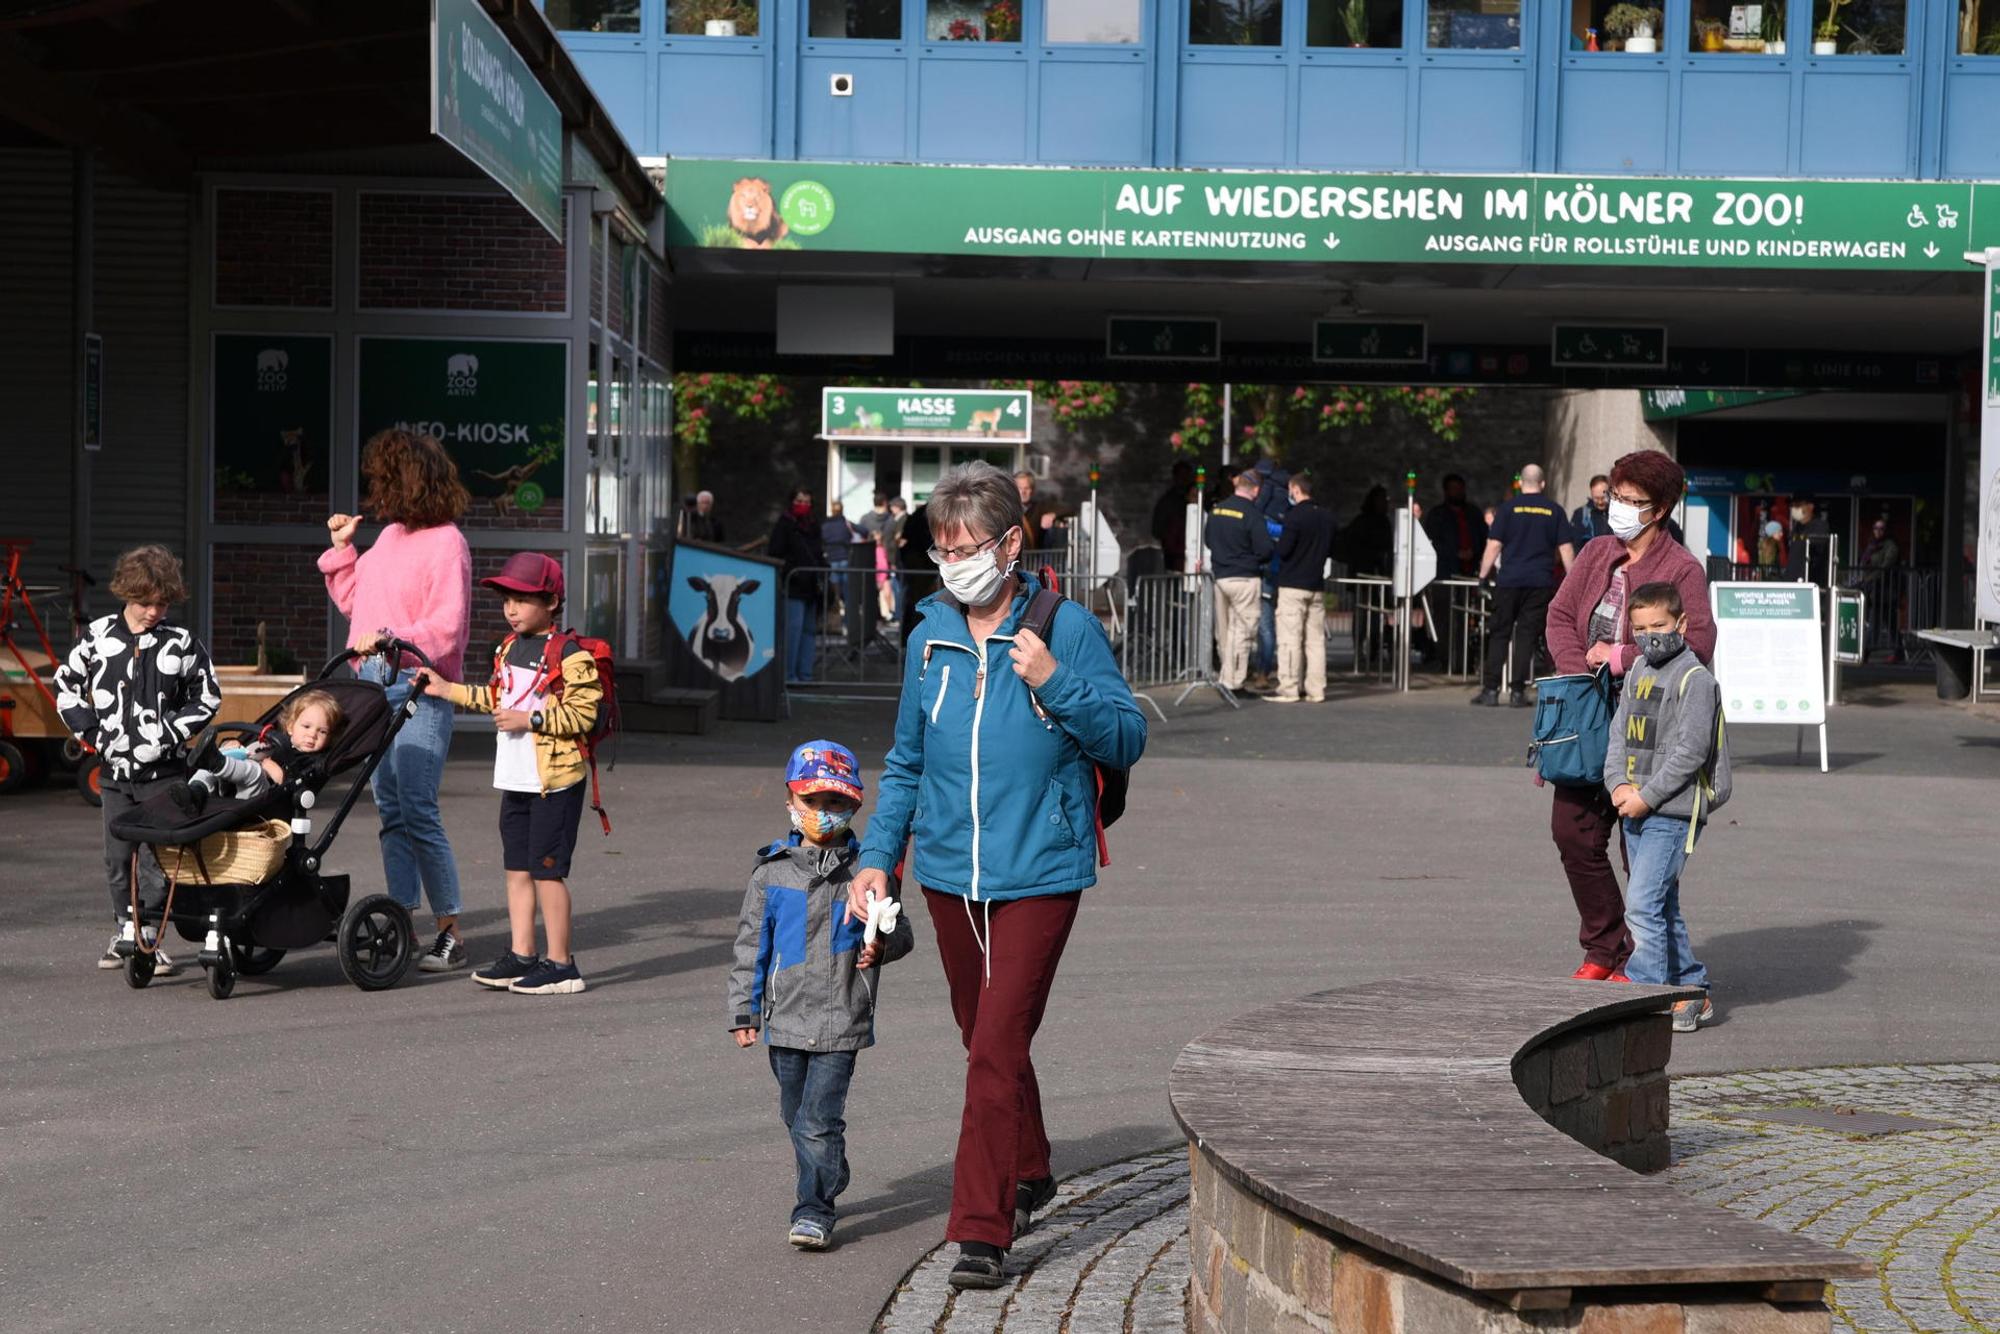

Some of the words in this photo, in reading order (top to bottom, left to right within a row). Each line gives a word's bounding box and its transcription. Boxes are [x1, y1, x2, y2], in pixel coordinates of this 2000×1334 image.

[1115, 184, 1185, 216] AUF
[1205, 185, 1463, 220] WIEDERSEHEN
[1484, 189, 1528, 220] IM
[1544, 183, 1692, 225] KÖLNER
[1713, 192, 1804, 226] ZOO!
[963, 228, 1062, 246] AUSGANG
[1067, 229, 1126, 247] OHNE
[1131, 230, 1307, 250] KARTENNUTZUNG
[1424, 234, 1523, 252] AUSGANG
[1528, 232, 1568, 254] FÜR
[1573, 234, 1700, 256] ROLLSTÜHLE
[1705, 239, 1751, 256] UND
[1756, 239, 1906, 259] KINDERWAGEN
[257, 371, 288, 384] ZOO
[447, 376, 478, 388] ZOO
[832, 396, 845, 415] 3
[897, 398, 956, 416] KASSE
[1006, 399, 1021, 417] 4
